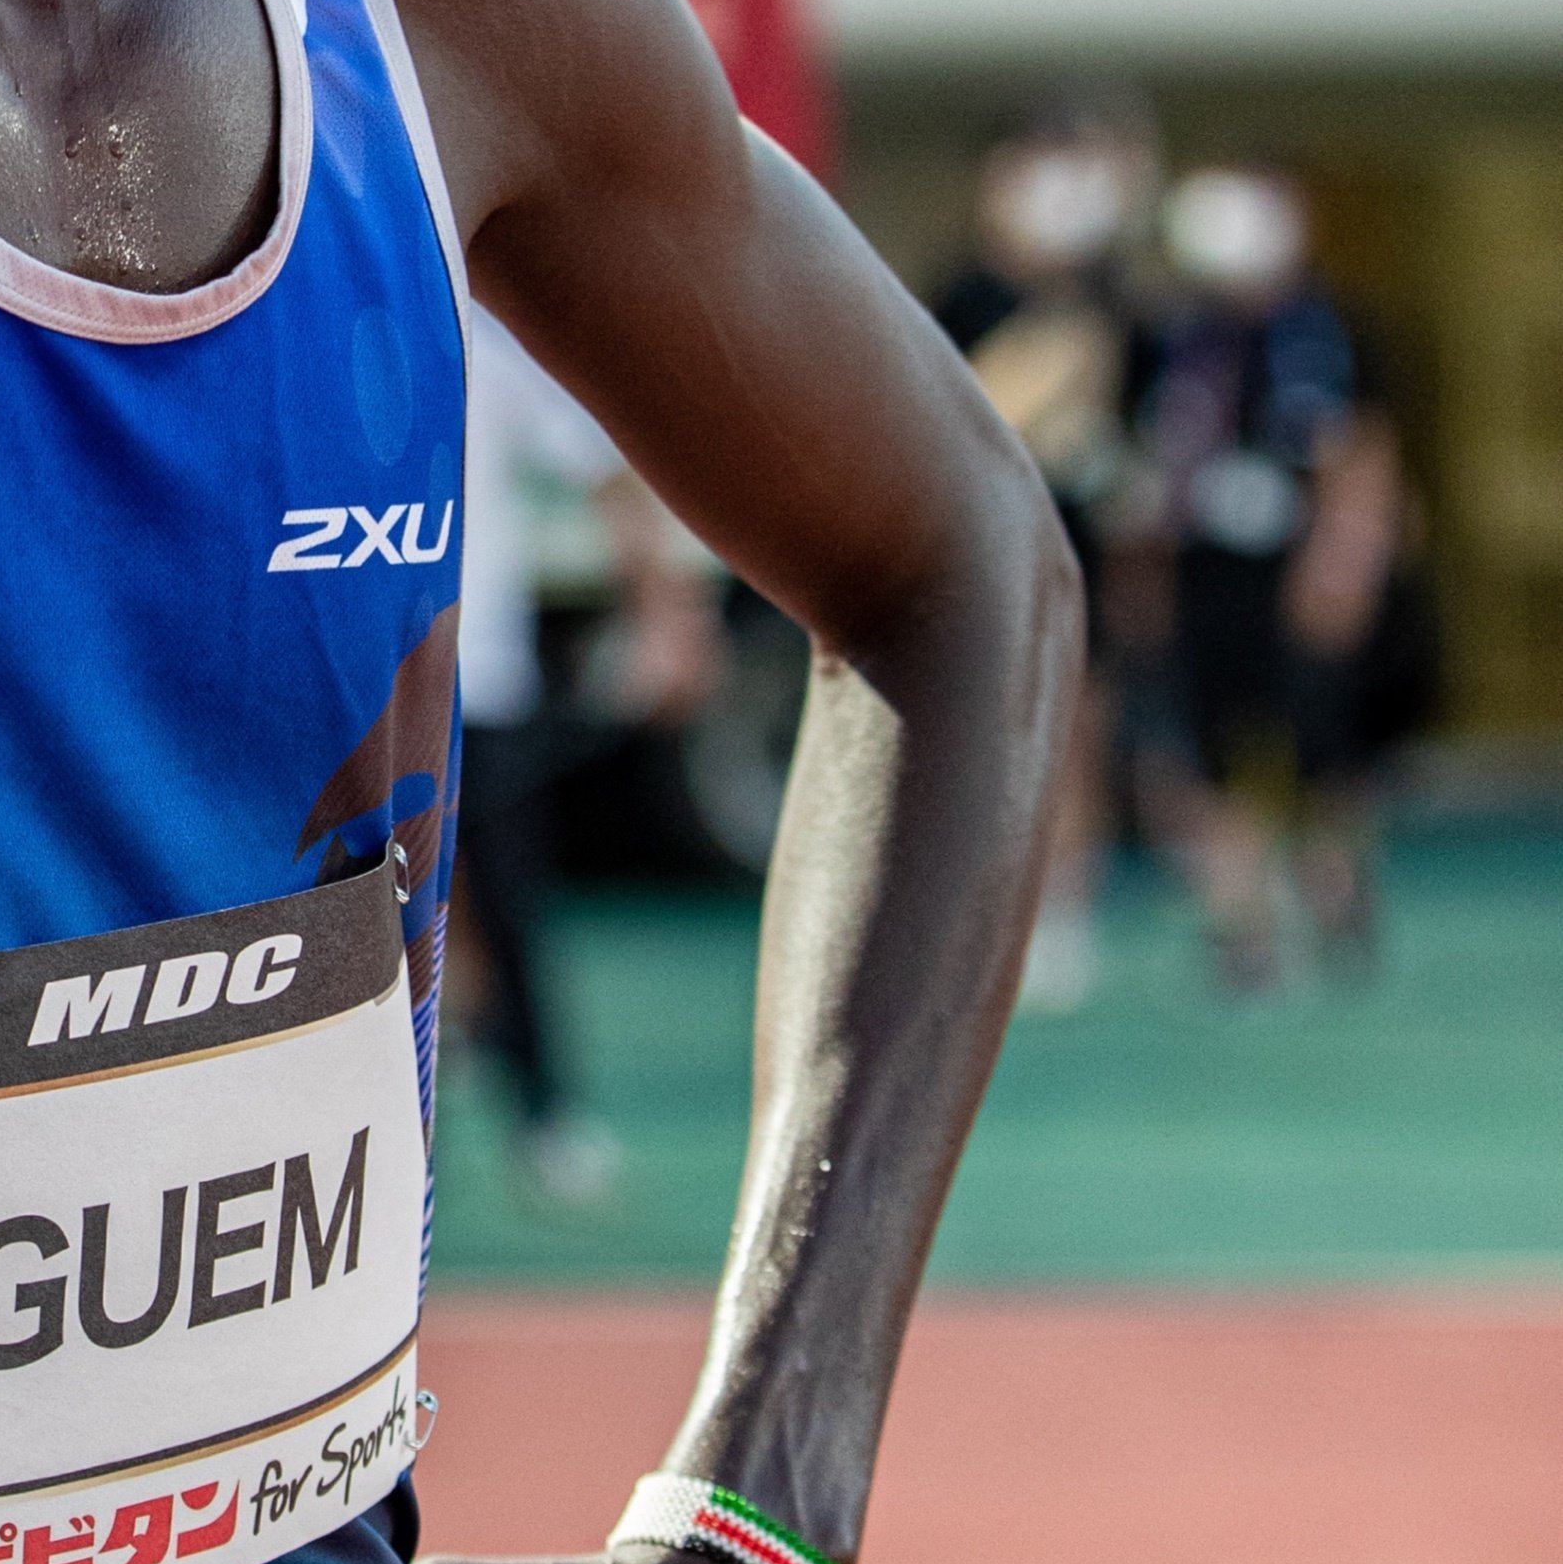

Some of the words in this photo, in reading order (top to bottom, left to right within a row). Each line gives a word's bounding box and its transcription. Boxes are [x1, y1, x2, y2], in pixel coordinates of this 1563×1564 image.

[267, 500, 455, 573] 2XU
[28, 934, 303, 1047] MDC
[250, 1459, 313, 1536] for
